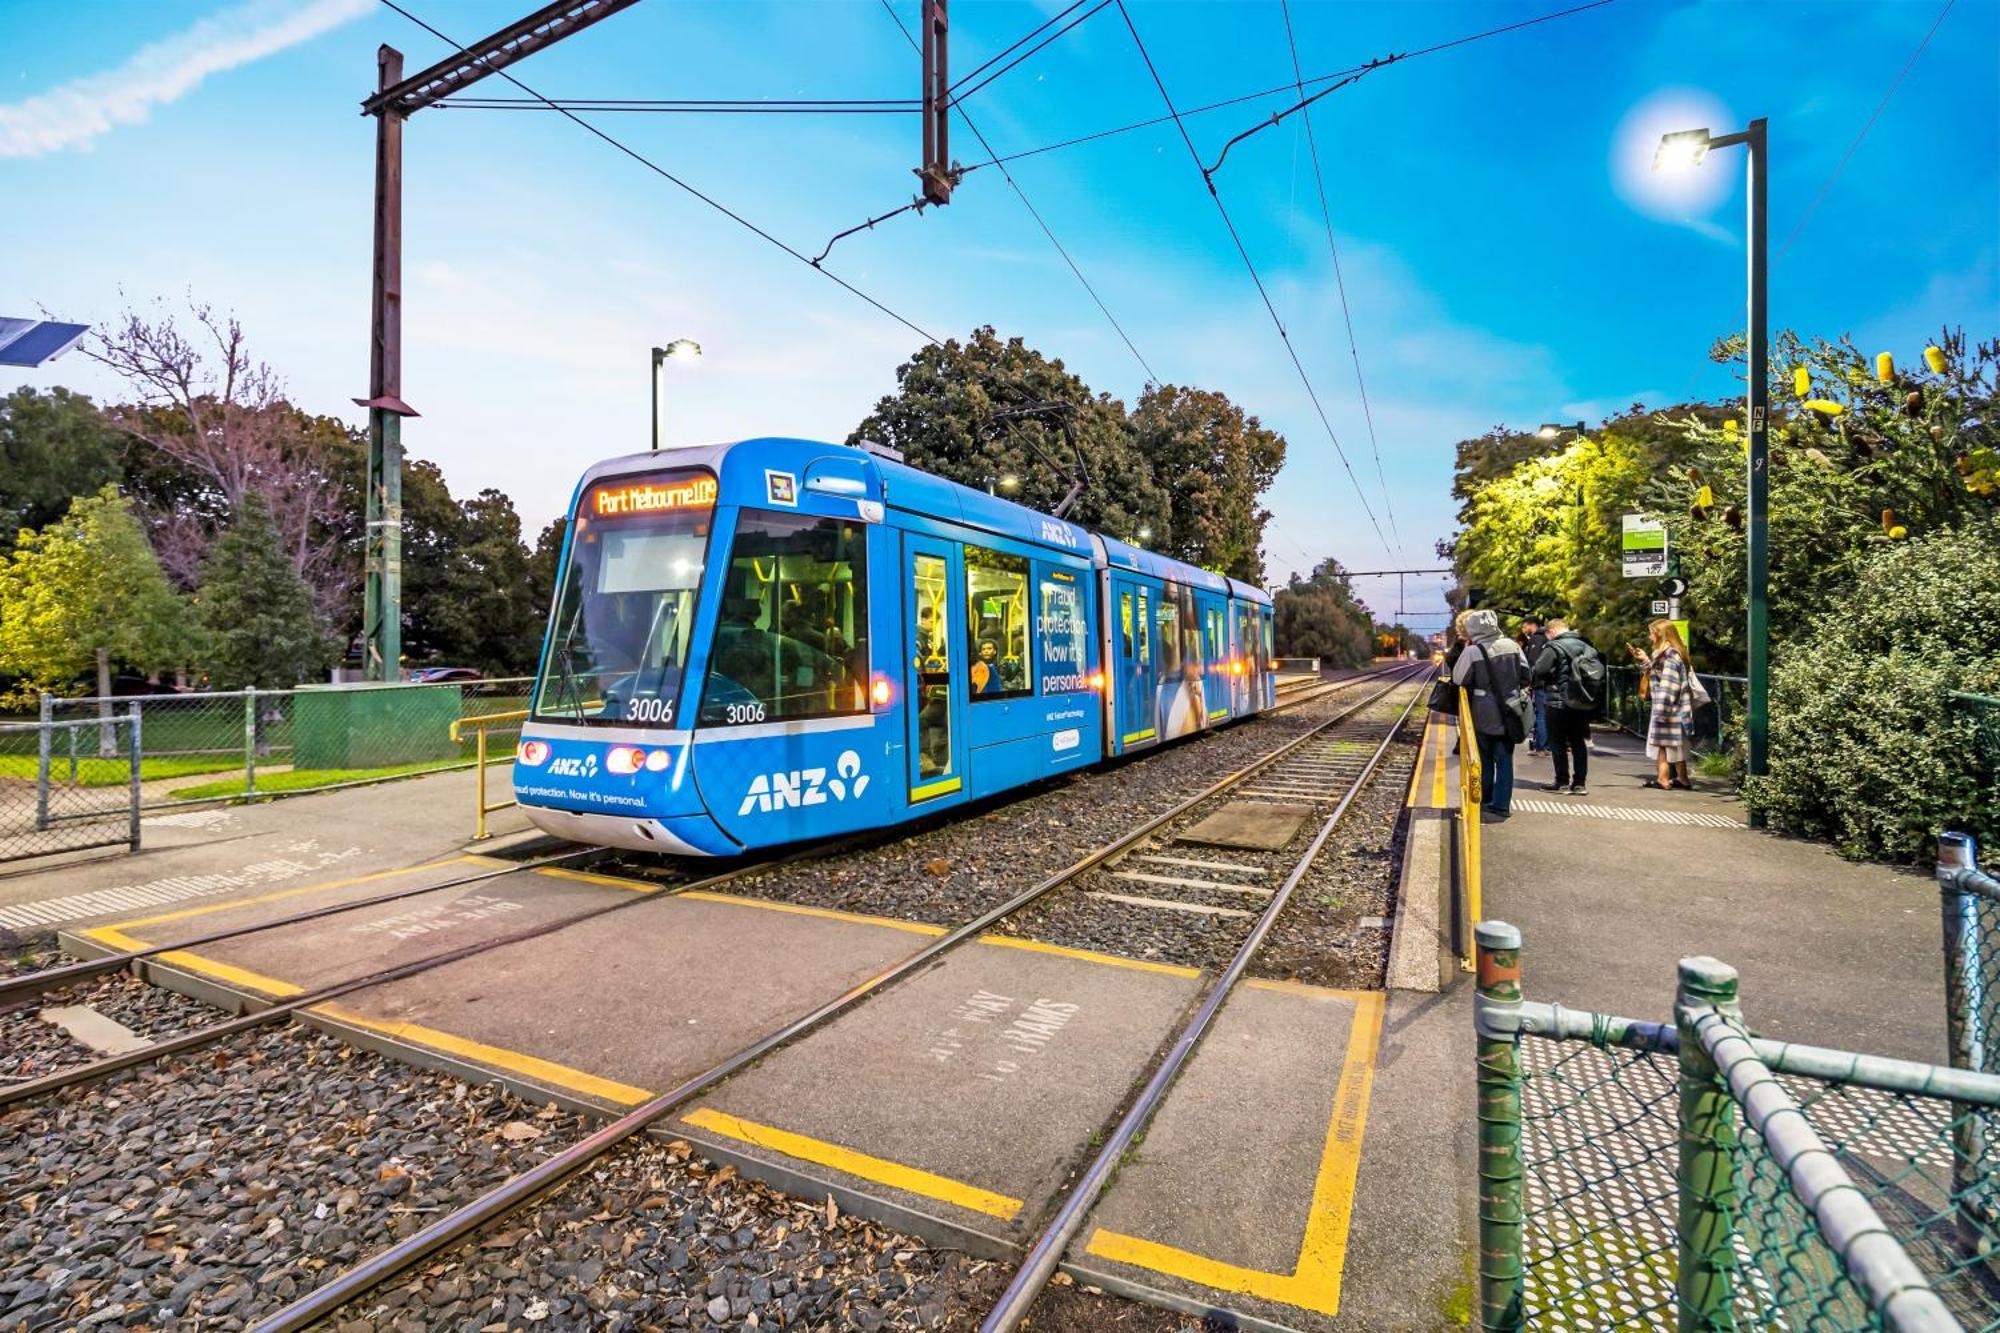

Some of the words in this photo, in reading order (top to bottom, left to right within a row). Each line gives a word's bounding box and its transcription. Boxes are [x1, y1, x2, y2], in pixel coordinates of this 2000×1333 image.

[599, 489, 628, 514] Port
[630, 484, 694, 512] Melbourne
[1044, 641, 1067, 662] Now
[626, 698, 673, 722] 3006
[726, 703, 766, 724] 3006
[547, 758, 581, 776] ANZ
[568, 788, 588, 801] Now
[589, 791, 601, 802] it's
[603, 793, 647, 808] personal.
[738, 767, 828, 816] ANZ
